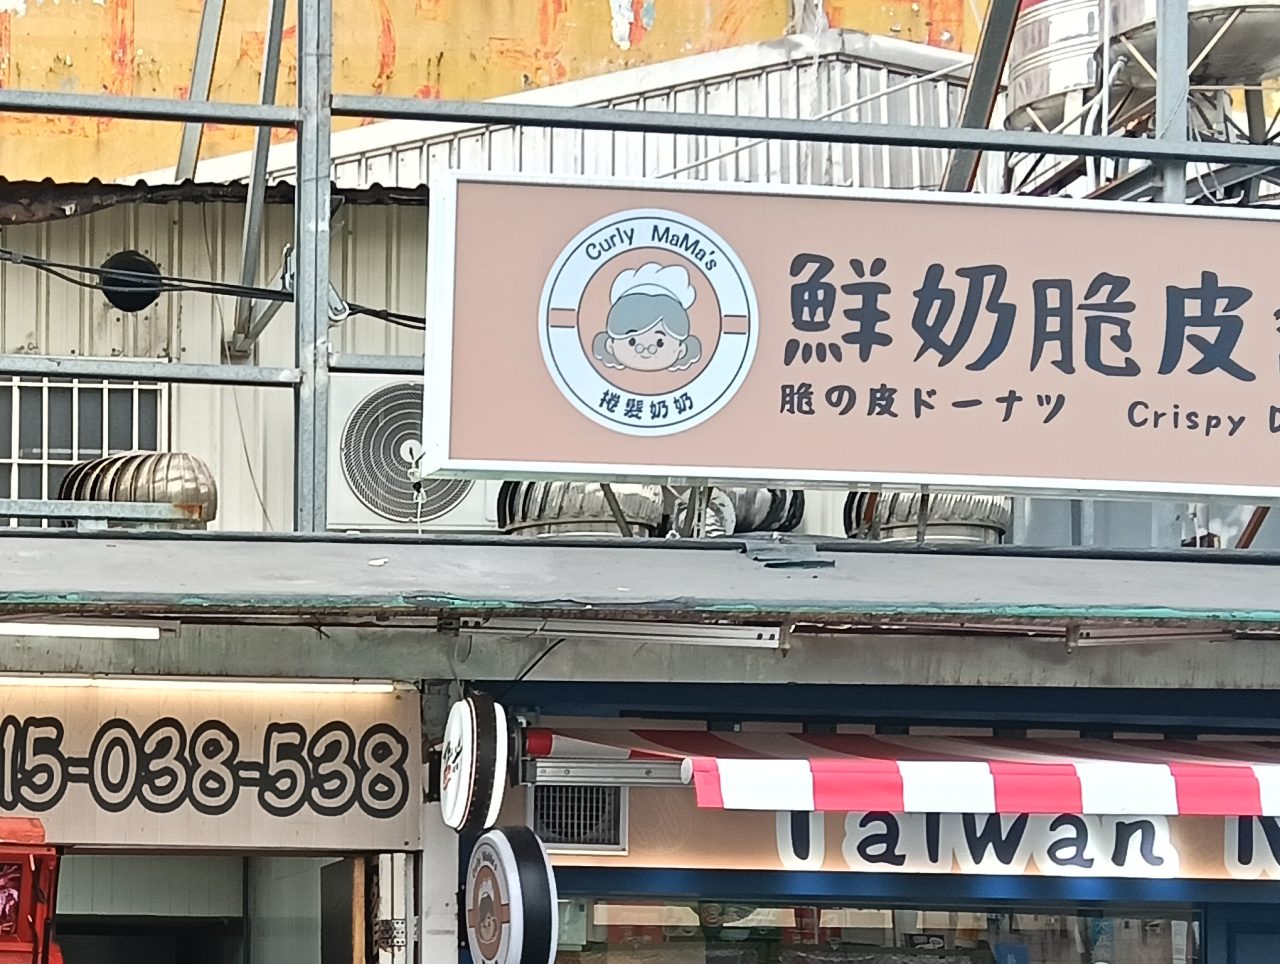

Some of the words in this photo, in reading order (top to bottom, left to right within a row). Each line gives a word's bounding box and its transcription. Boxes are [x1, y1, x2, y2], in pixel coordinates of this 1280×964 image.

[584, 225, 636, 262] Curly
[651, 225, 720, 273] MaMa's
[783, 253, 1280, 384] 鮮奶脆皮
[779, 382, 1067, 425] 脆の皮ドーナツ
[1127, 400, 1246, 437] Crispy
